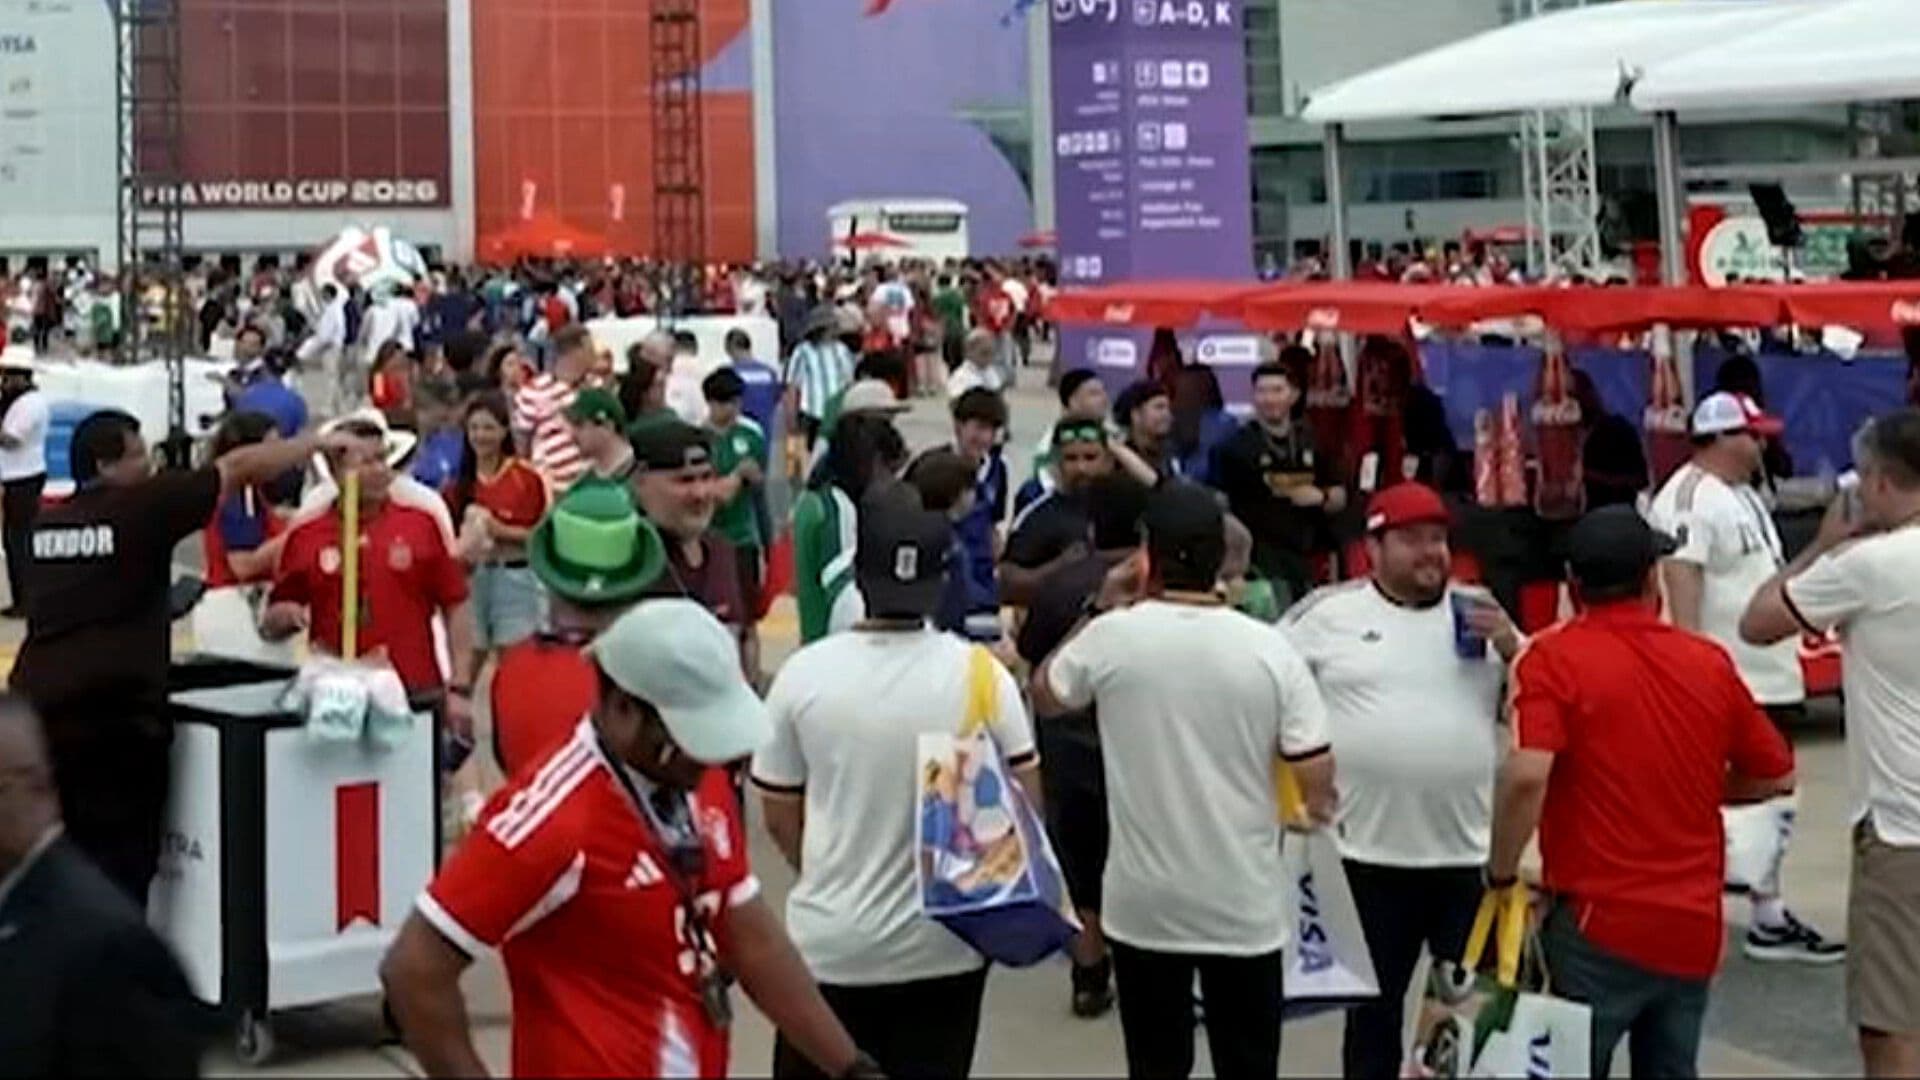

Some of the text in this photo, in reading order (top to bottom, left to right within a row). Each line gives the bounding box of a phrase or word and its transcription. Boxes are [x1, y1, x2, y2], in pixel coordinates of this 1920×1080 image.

[1215, 2, 1231, 24] K
[201, 181, 293, 203] WORLD
[296, 181, 347, 203] CUP
[352, 180, 438, 203] 2026
[33, 526, 114, 557] VENDOR
[1298, 872, 1334, 974] VISA
